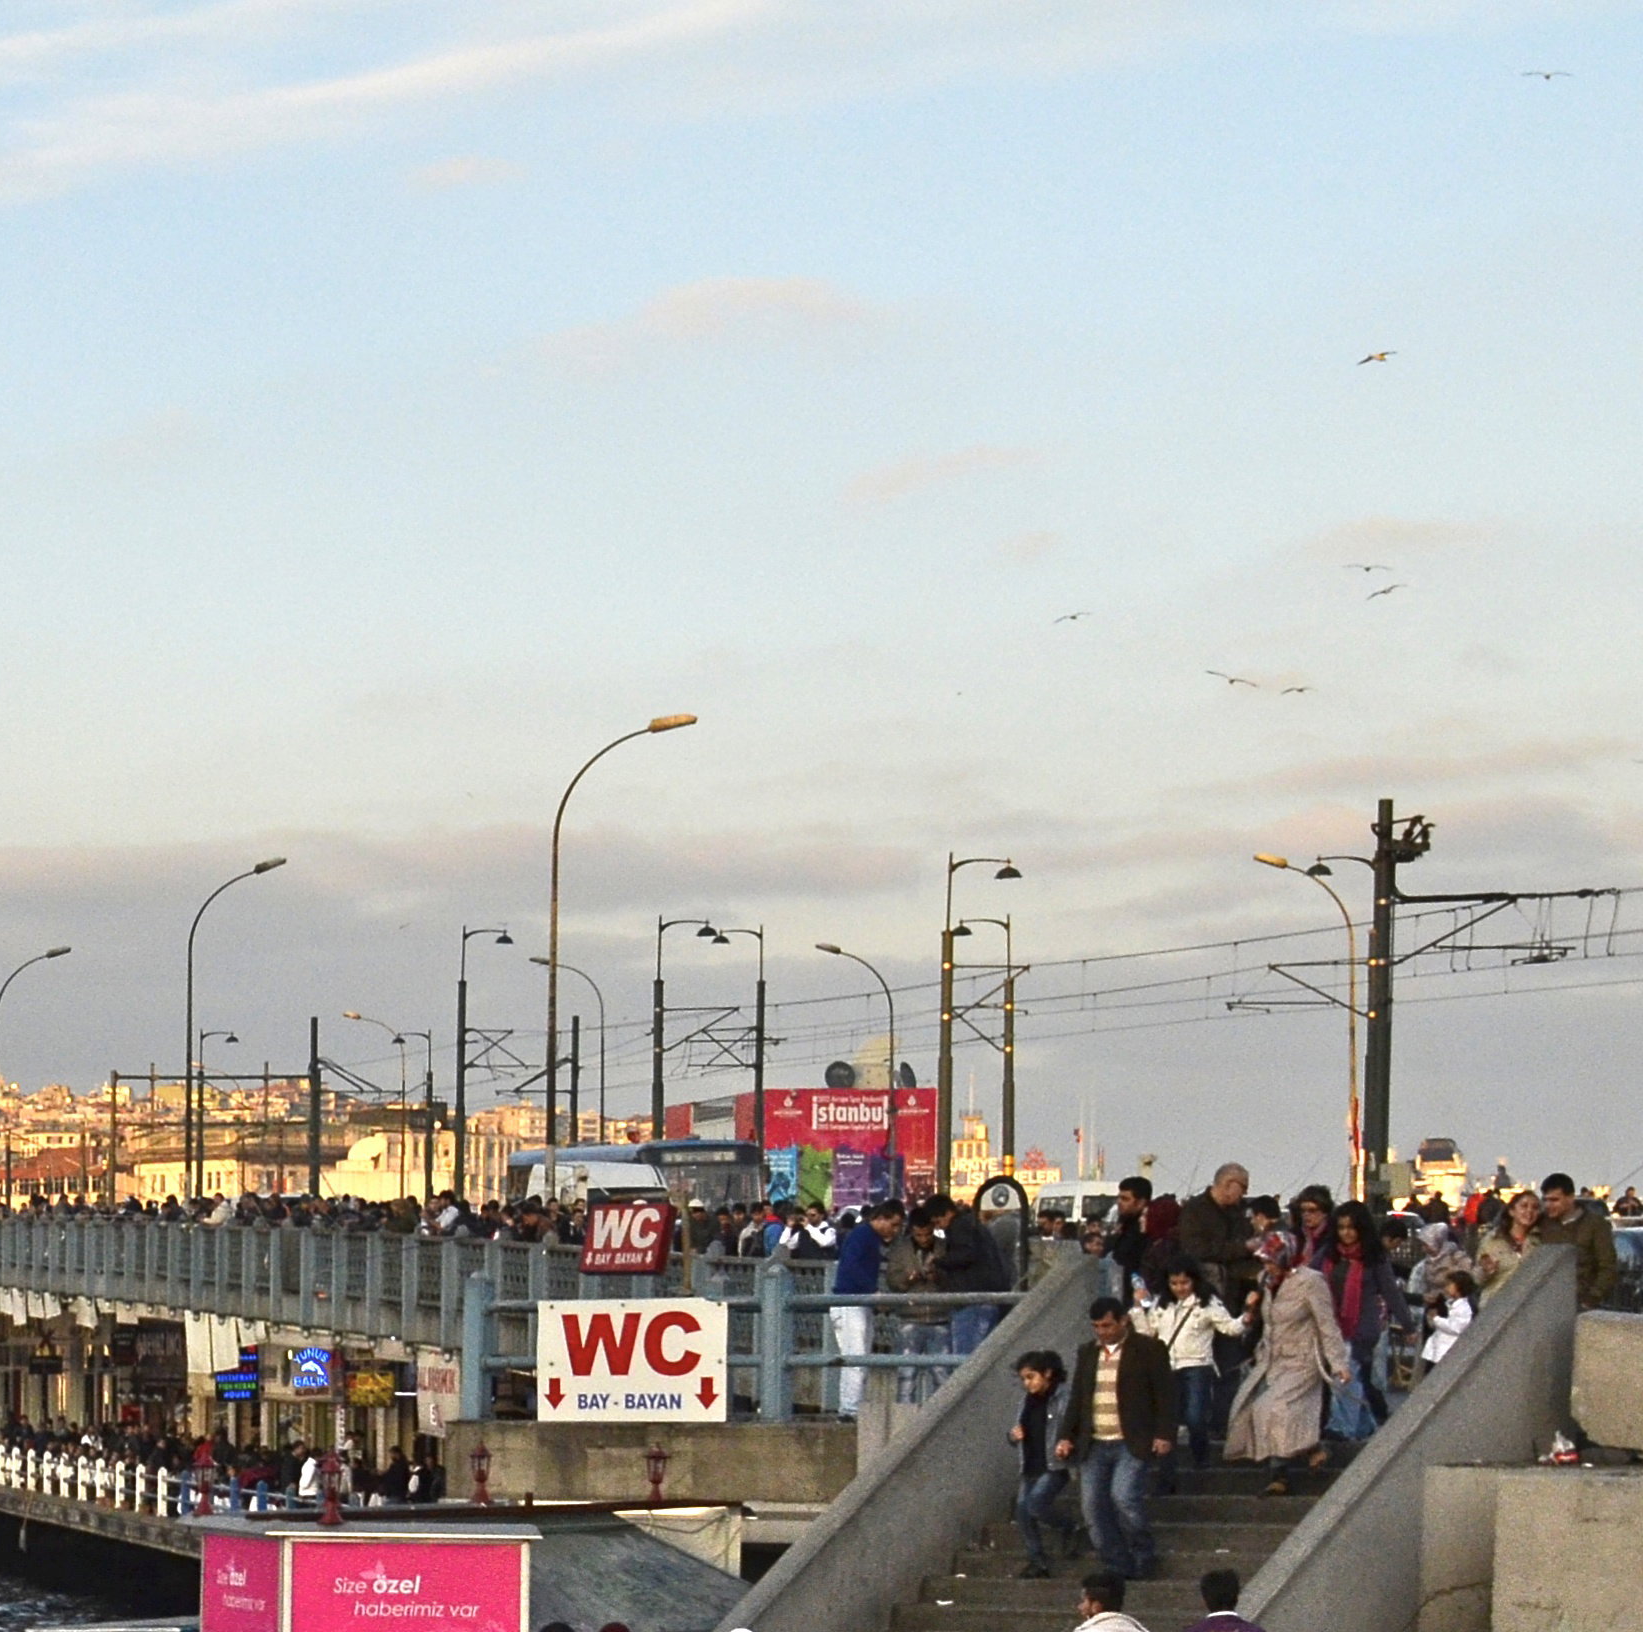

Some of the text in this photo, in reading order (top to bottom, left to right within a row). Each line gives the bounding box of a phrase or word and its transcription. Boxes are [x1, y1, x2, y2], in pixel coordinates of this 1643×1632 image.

[592, 1208, 660, 1249] WC
[595, 1251, 643, 1265] BAY BAYAN
[561, 1311, 702, 1376] WC
[293, 1348, 329, 1363] YUNUS
[578, 1394, 610, 1409] BAY
[624, 1394, 682, 1409] BAYAN
[229, 1568, 247, 1587] özel
[333, 1575, 421, 1595] Size özel
[354, 1601, 480, 1618] haberimiz var
